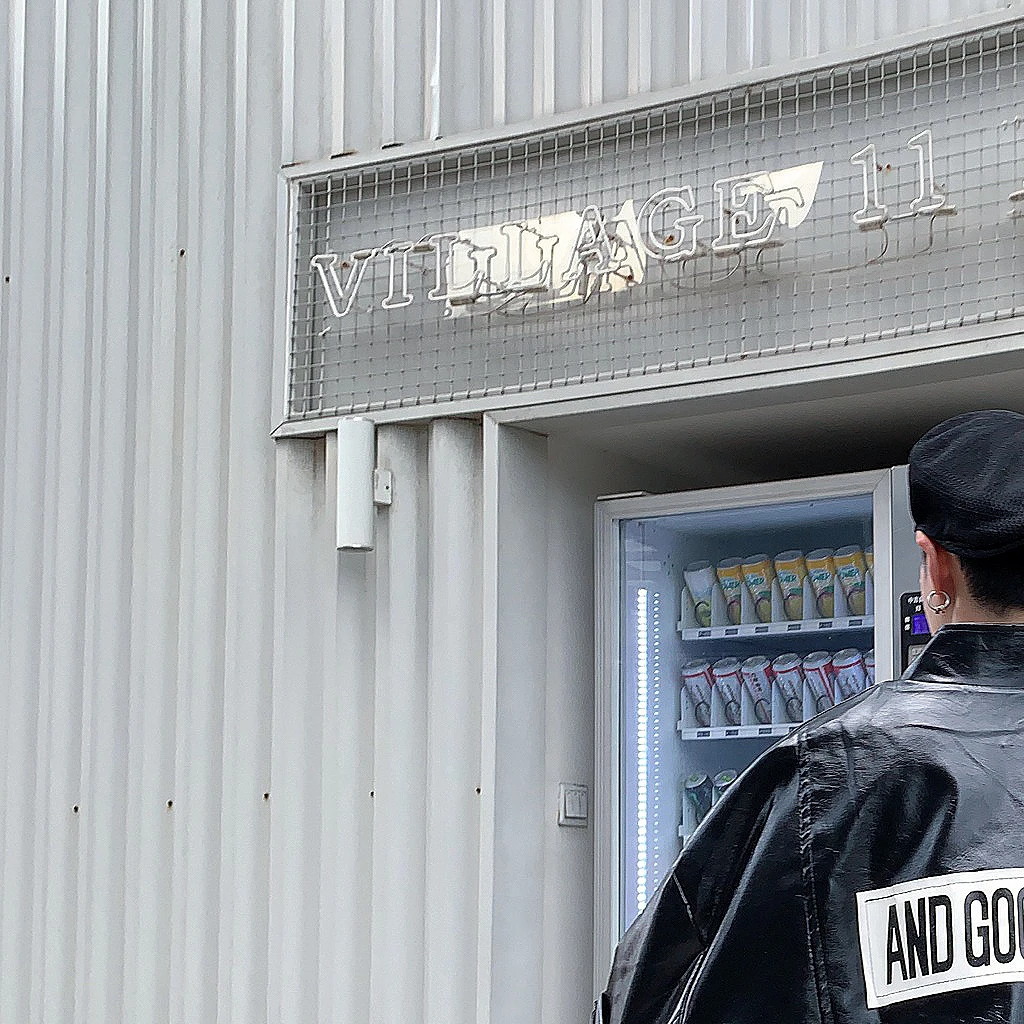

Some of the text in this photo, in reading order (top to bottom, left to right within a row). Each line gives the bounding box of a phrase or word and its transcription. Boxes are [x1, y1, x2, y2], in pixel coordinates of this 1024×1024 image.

[310, 171, 775, 319] VILLAGE
[850, 129, 948, 222] 11
[886, 894, 954, 985] AND
